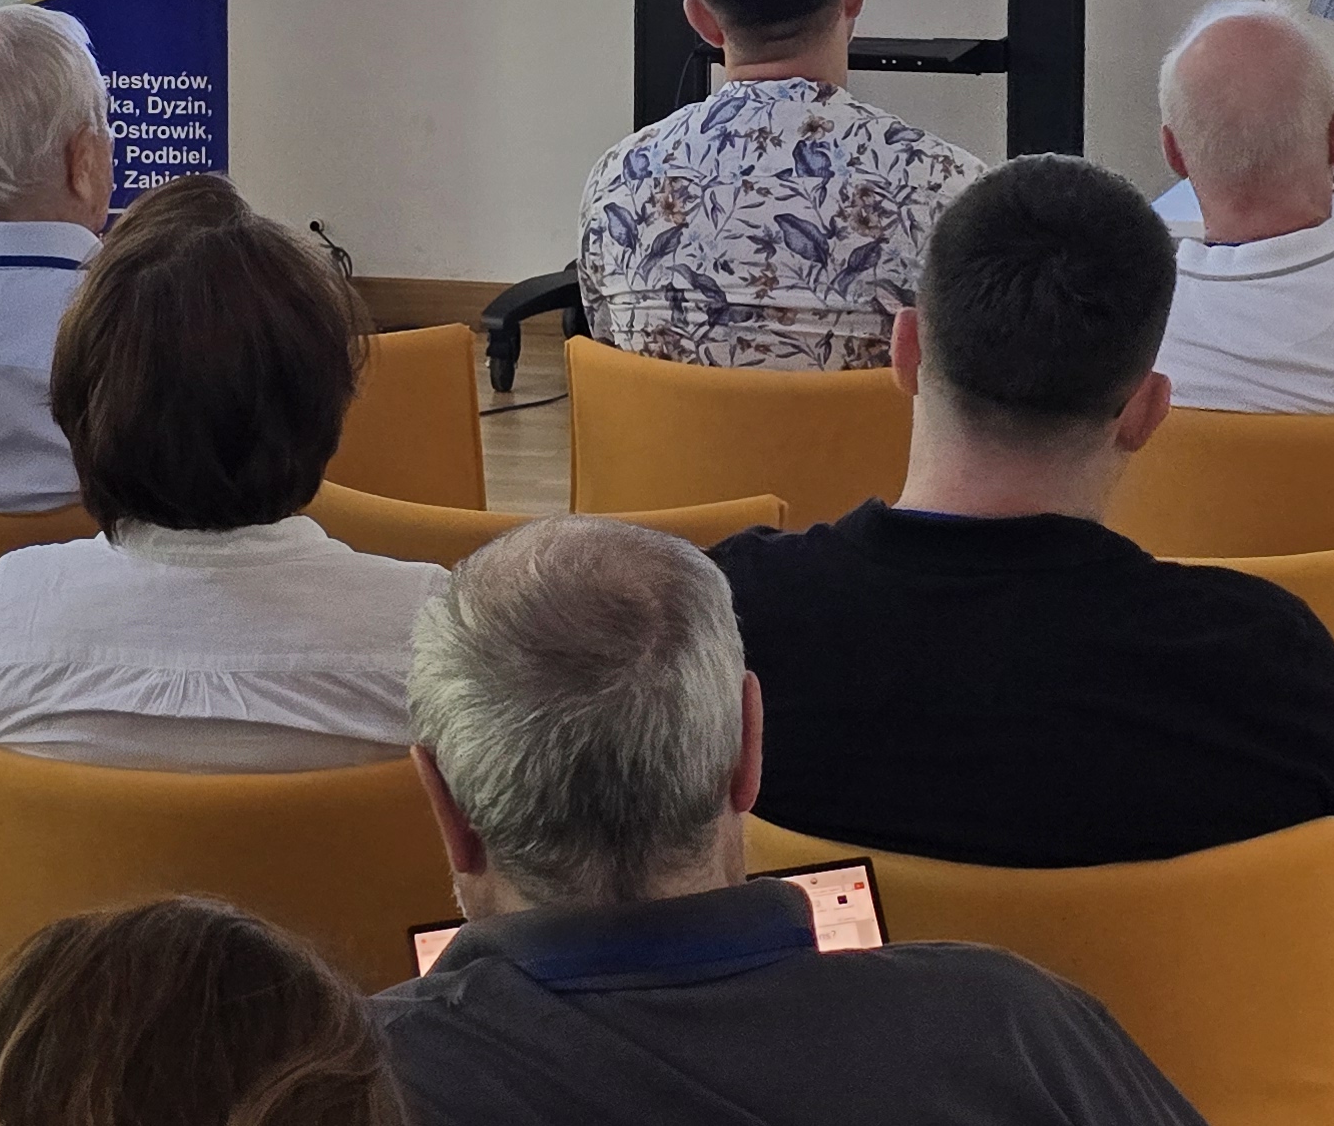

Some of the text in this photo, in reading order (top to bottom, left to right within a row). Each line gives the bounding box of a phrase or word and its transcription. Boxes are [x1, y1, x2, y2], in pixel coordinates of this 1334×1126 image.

[103, 71, 212, 93] elestynów,
[147, 96, 212, 118] Dyzin,
[112, 120, 212, 141] Ostrowik,
[126, 145, 212, 167] Podbiel,
